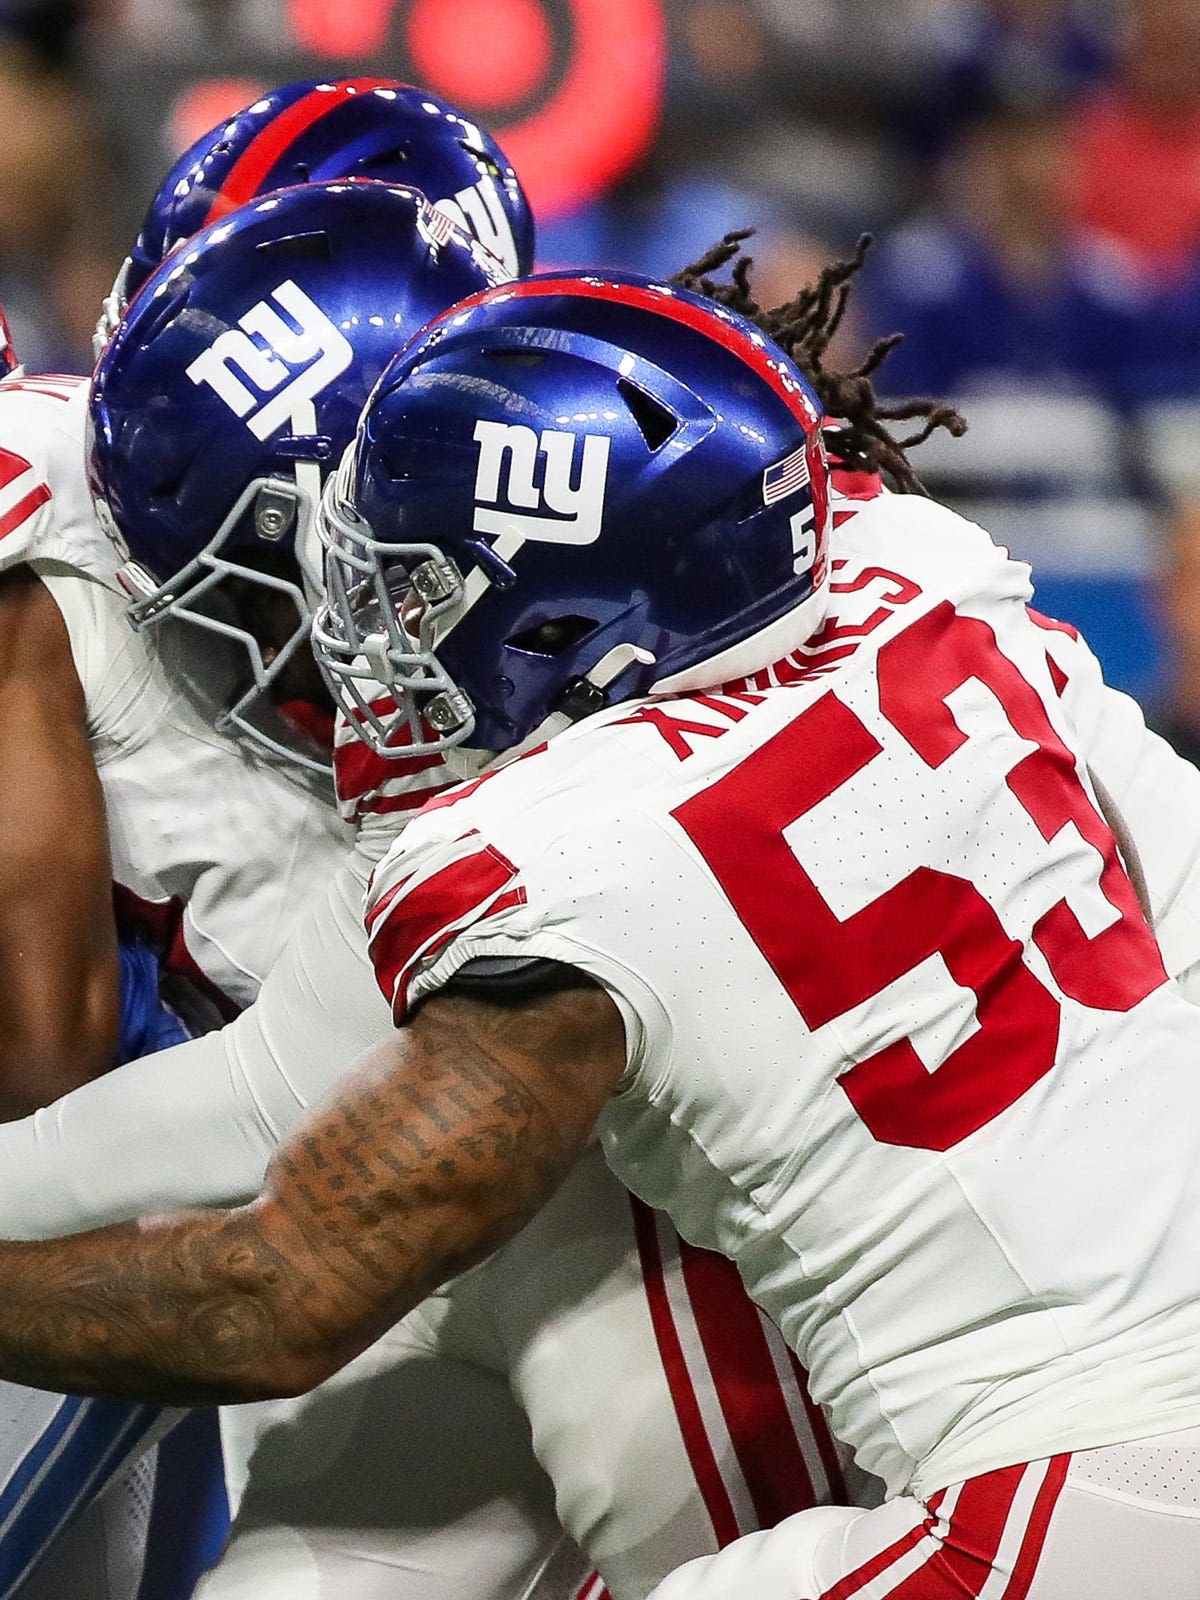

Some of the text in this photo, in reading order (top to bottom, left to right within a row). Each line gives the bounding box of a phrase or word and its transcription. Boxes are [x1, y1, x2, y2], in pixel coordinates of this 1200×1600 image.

[185, 279, 353, 441] ny
[473, 420, 611, 545] ny
[790, 503, 816, 575] 5
[669, 599, 1169, 1152] 53
